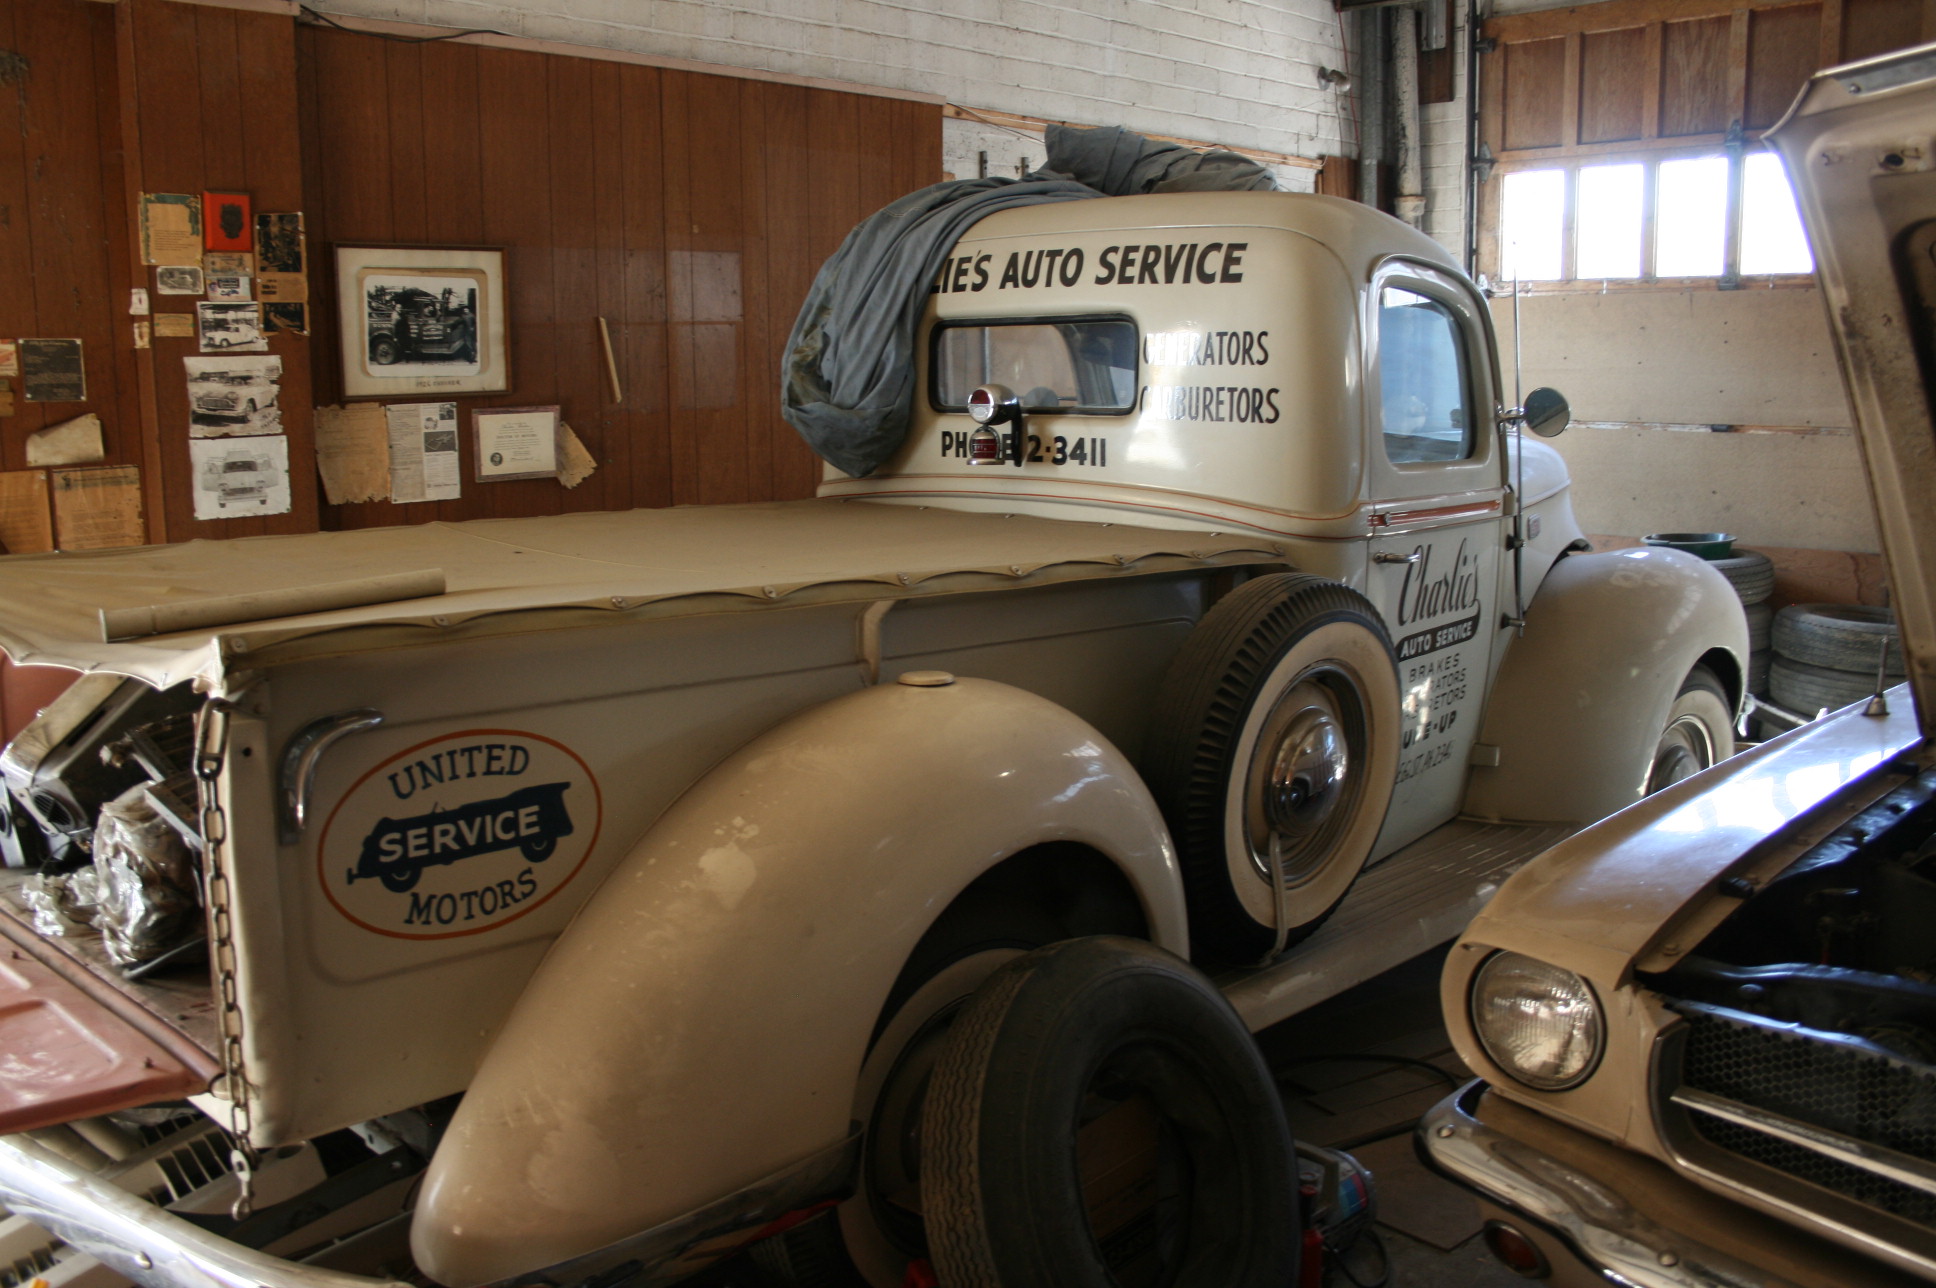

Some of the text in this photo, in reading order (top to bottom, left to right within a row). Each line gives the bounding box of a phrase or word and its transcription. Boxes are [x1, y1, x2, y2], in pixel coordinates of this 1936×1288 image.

[998, 247, 1084, 289] AUTO
[1094, 242, 1248, 286] SERVICE
[941, 430, 1014, 462] PHE
[1400, 620, 1473, 658] AUTO SERVICE
[1409, 653, 1460, 683] BRAKES
[1402, 709, 1457, 749] UE-UP
[387, 743, 530, 800] UNITED
[378, 804, 542, 863] SERVICE
[403, 866, 538, 926] MOTORS
